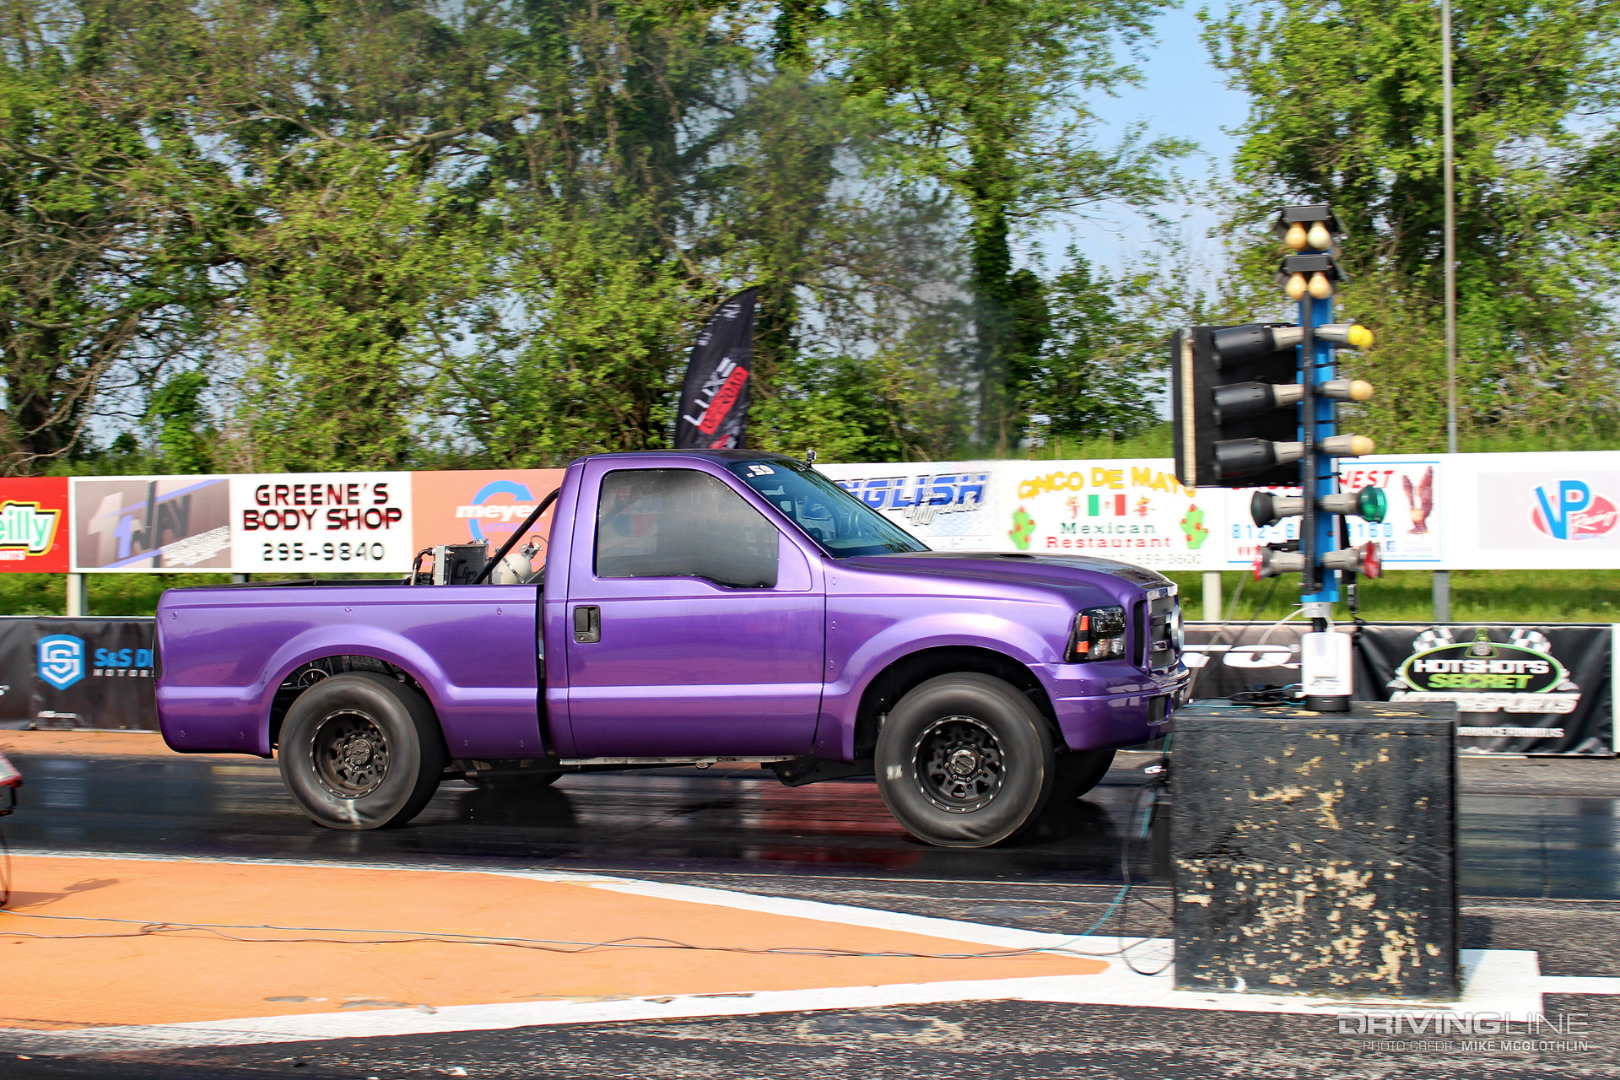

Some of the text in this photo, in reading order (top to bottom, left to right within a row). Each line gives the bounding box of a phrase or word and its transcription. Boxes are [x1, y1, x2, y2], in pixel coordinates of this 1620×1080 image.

[255, 482, 389, 506] GREENE'S
[833, 471, 990, 511] NGLISH
[1018, 472, 1084, 499] CINCO
[1091, 467, 1125, 490] DE
[243, 507, 403, 531] BODY SHOP
[1534, 480, 1590, 540] VP
[1060, 522, 1156, 535] Mexican
[262, 541, 385, 562] 295-9840
[1046, 536, 1172, 549] Restaurant
[92, 647, 134, 668] S&S
[1427, 674, 1535, 690] SECRET
